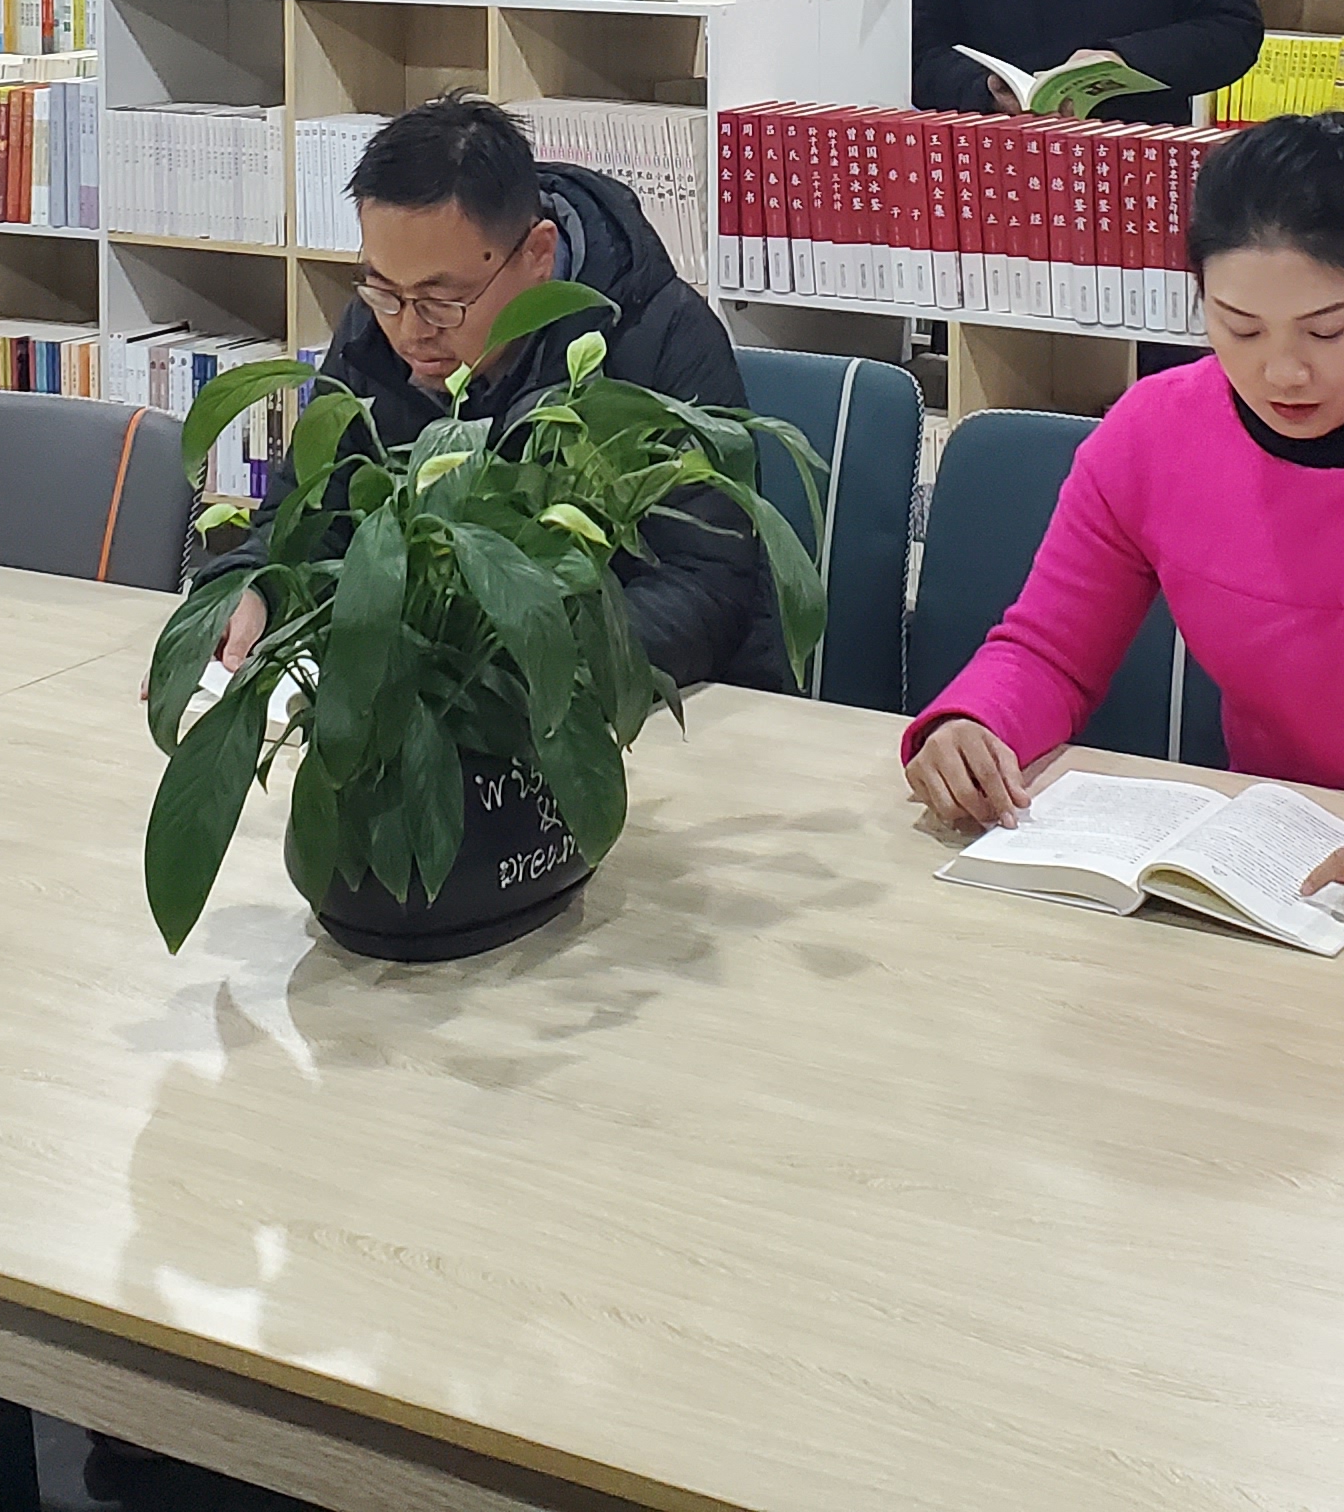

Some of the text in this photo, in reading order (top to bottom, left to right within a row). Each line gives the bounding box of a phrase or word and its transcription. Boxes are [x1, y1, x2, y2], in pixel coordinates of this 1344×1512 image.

[719, 122, 733, 204] 周易全书
[742, 123, 755, 205] 周易全书
[765, 124, 780, 209] 吕氏春秋
[787, 125, 803, 210] 吕氏春秋
[807, 126, 823, 209] 孙子兵法 三十六计
[827, 128, 843, 212] 孙子兵法 三十六计
[845, 126, 865, 211] 曾国藩冰鉴
[864, 127, 884, 211] 曾国藩冰鉴
[928, 134, 946, 218] 王阳明全集
[956, 135, 974, 220] 王阳明全集
[981, 136, 999, 225] 古文观止
[1003, 138, 1021, 227] 古文观止
[1026, 139, 1043, 226] 道德经
[1049, 141, 1067, 227] 道德经
[1071, 143, 1087, 232] 古诗词鉴赏
[1095, 143, 1112, 232] 古诗词鉴赏
[1121, 148, 1139, 235] 增广贤文
[1143, 146, 1160, 234] 增广贤文
[1167, 146, 1180, 235] 中华名言警句精粹
